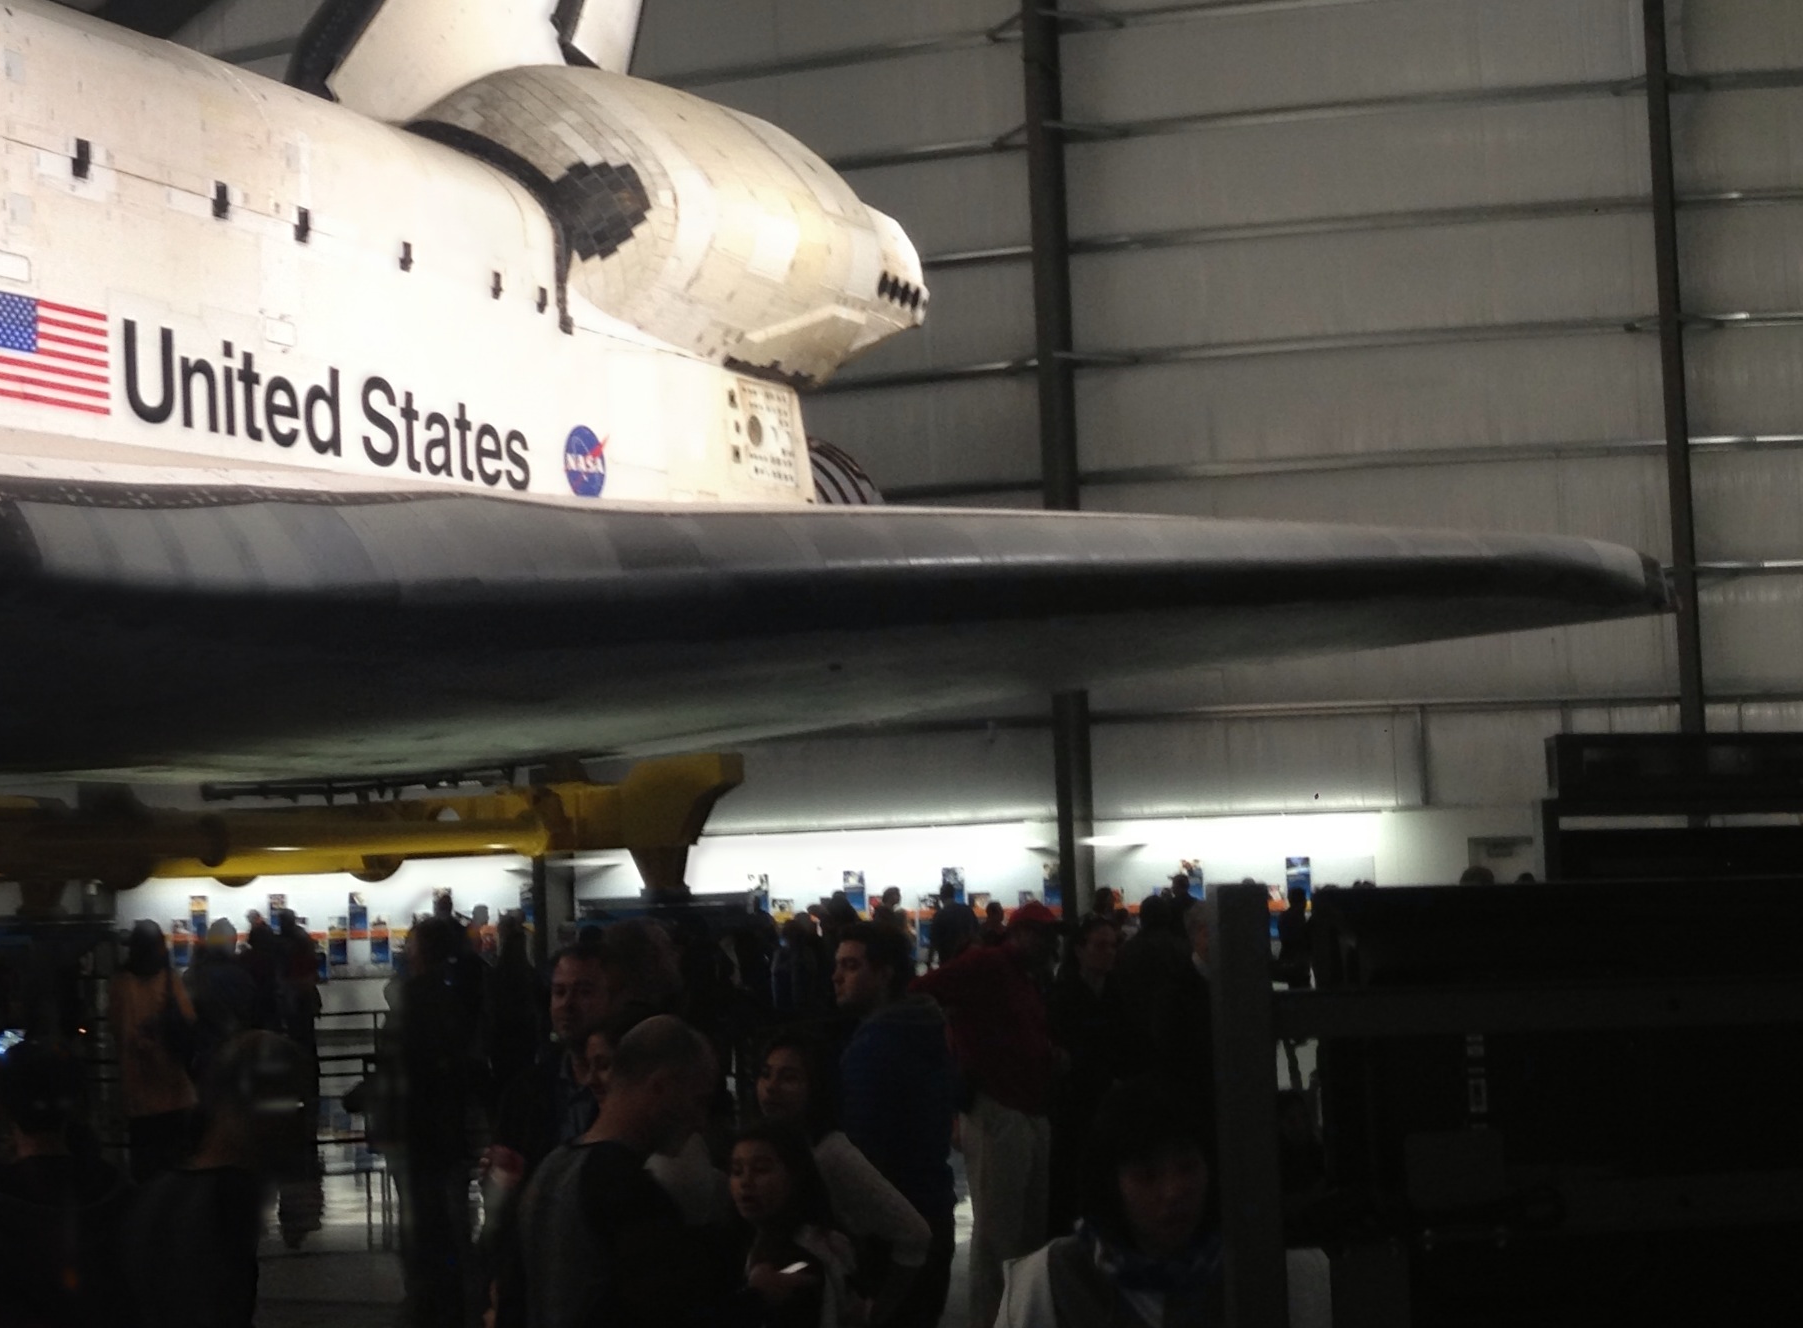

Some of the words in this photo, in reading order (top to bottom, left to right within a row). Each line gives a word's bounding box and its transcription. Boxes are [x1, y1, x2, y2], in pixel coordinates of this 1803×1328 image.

[122, 317, 343, 457] United
[361, 376, 531, 492] States
[564, 452, 605, 475] NASA
